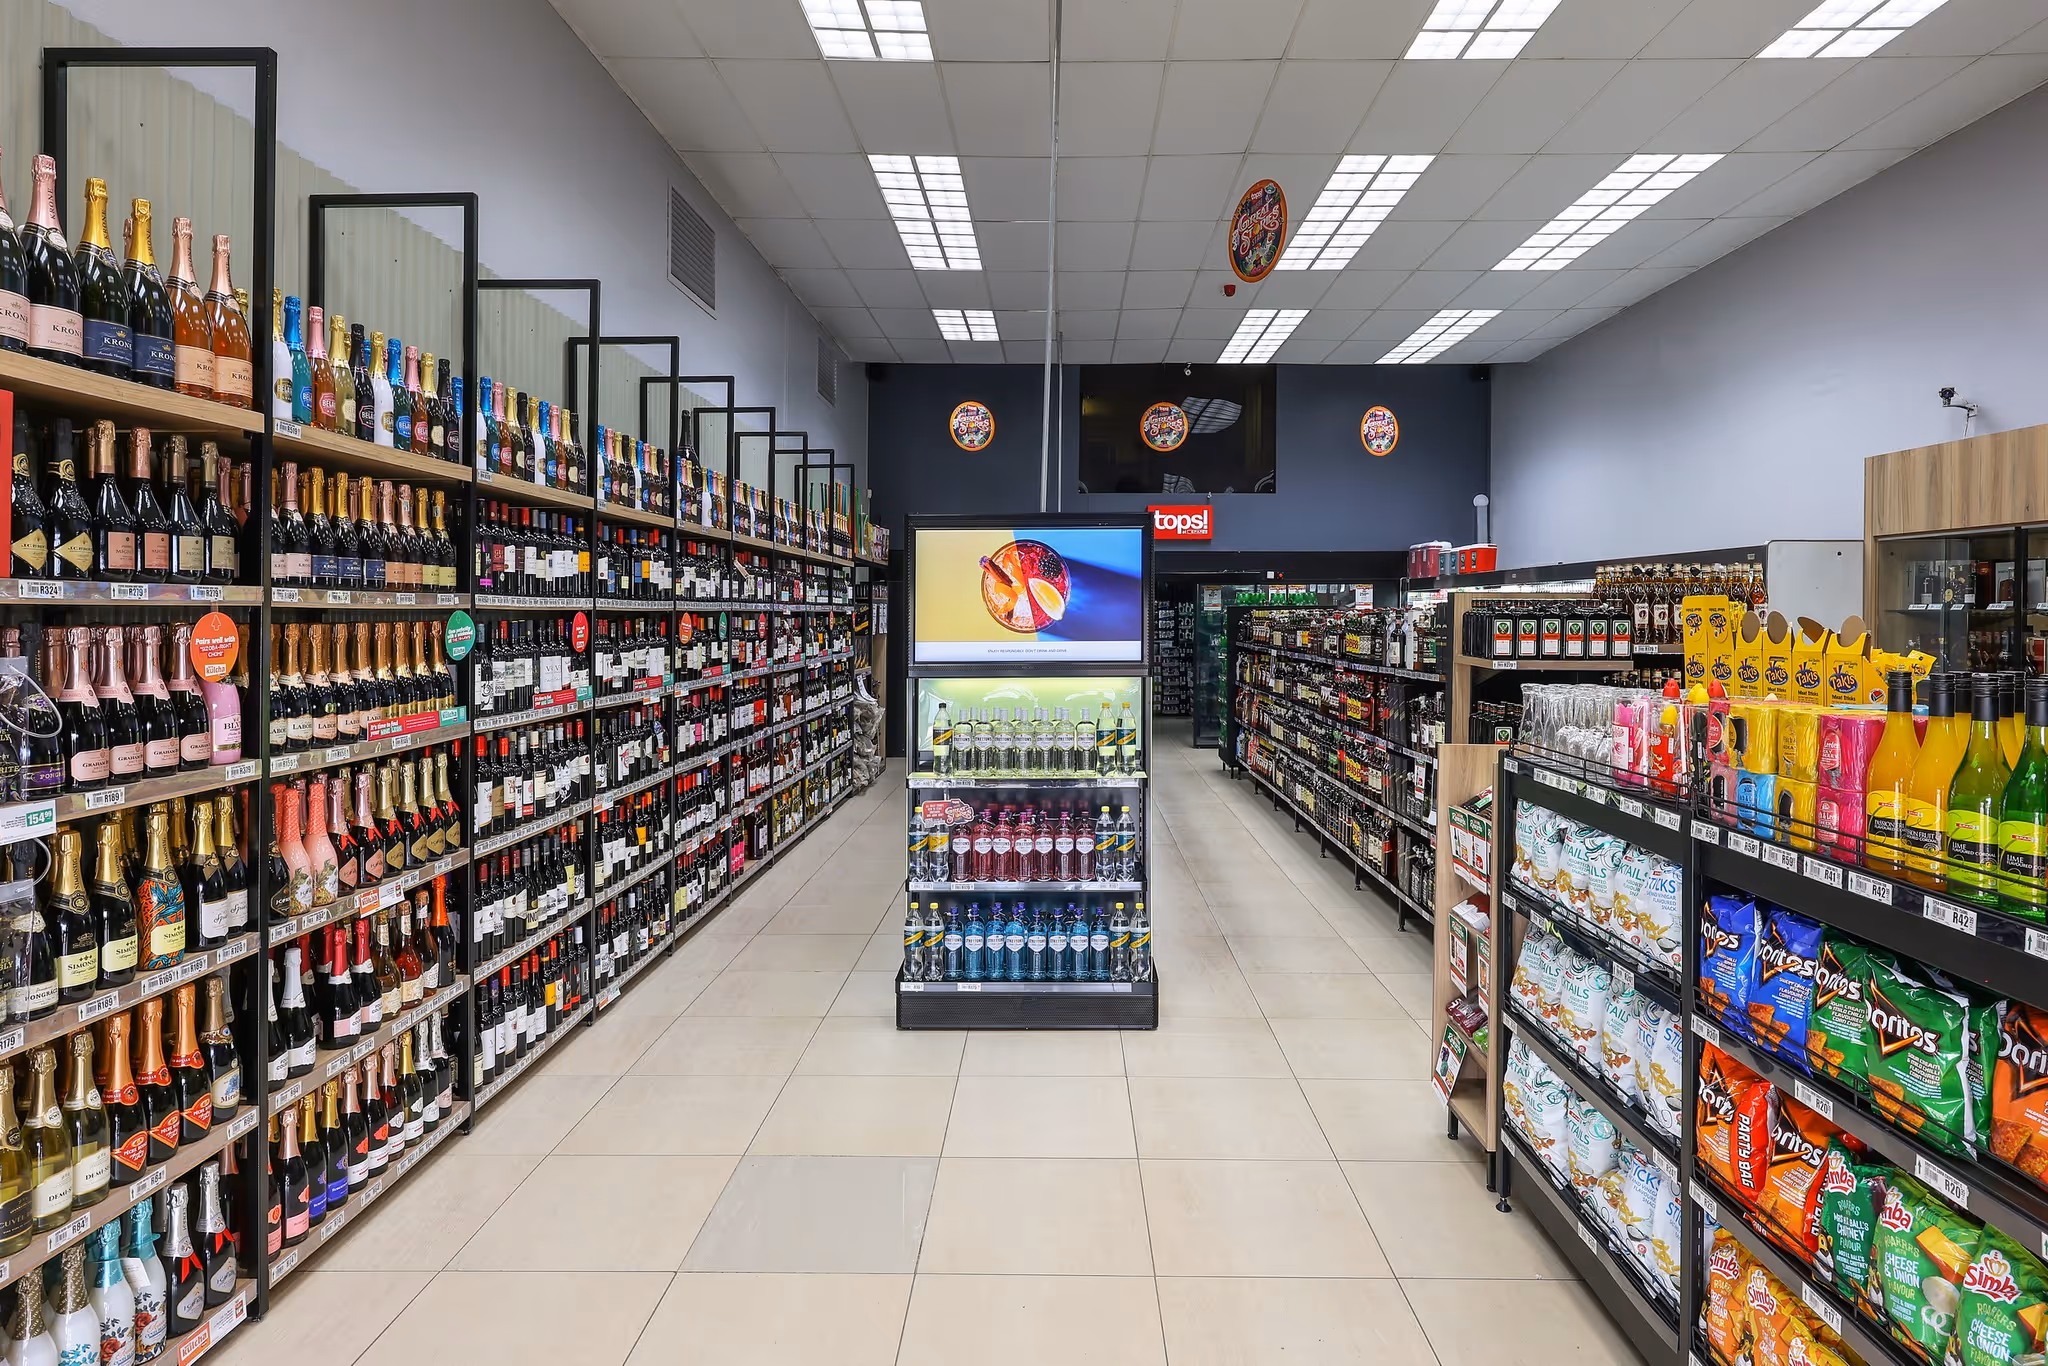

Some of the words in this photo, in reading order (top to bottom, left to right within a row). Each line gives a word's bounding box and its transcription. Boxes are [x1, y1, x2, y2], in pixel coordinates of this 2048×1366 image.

[1153, 509, 1208, 535] tops!
[39, 585, 58, 596] R324
[1686, 662, 1704, 675] Takis
[1711, 664, 1731, 676] Takis
[1737, 666, 1758, 680] Takis
[1764, 667, 1788, 682] Takis
[1795, 668, 1820, 686] Takis
[1828, 672, 1856, 690] Takis
[27, 812, 45, 825] 154
[1920, 831, 1935, 840] FRUIT
[1952, 841, 1967, 850] LIME
[1781, 854, 1793, 867] R59
[2006, 854, 2024, 863] LIME
[1824, 869, 1836, 882] R41
[1872, 884, 1886, 899] R42
[1952, 912, 1969, 928] R42
[97, 997, 113, 1012] R189
[1909, 1065, 1941, 1082] FLAVOURED
[1815, 1101, 1828, 1115] R20
[1738, 1113, 1752, 1159] PARTY
[1738, 1160, 1755, 1189] BAG
[1944, 1180, 1962, 1200] R20
[72, 1222, 85, 1234] R84
[1884, 1252, 1920, 1275] CHEESE
[1884, 1264, 1892, 1278] &
[1893, 1267, 1920, 1289] ONION
[1964, 1264, 2021, 1300] Simba
[1748, 1285, 1775, 1313] Simba
[1971, 1318, 2012, 1348] CHEESE
[1967, 1332, 1975, 1344] &
[1977, 1335, 2010, 1362] ONION
